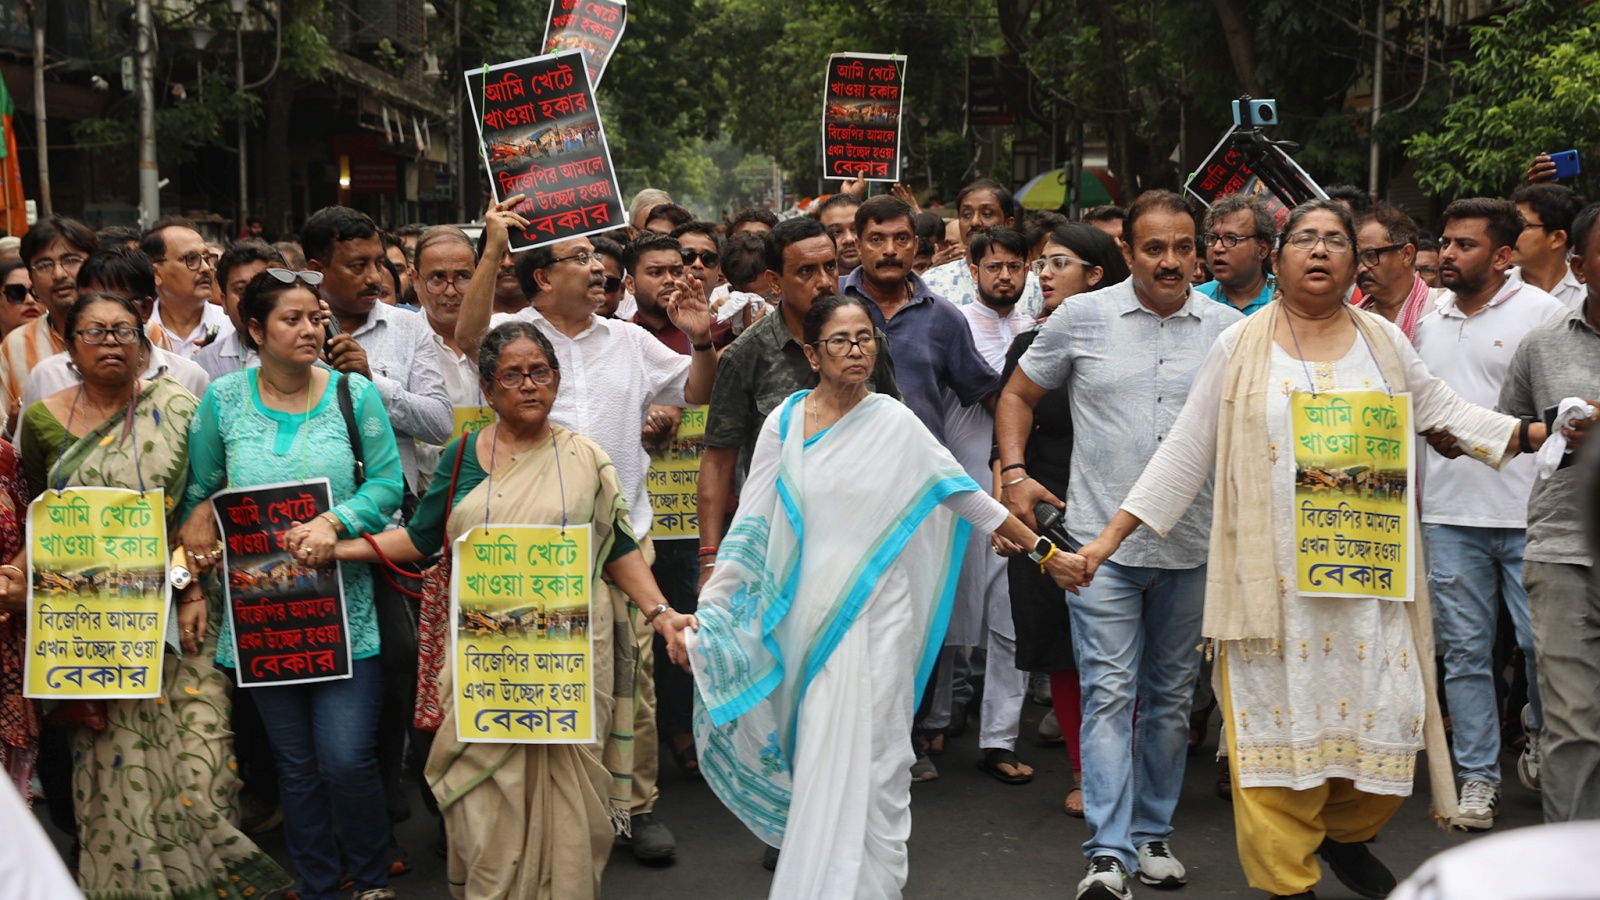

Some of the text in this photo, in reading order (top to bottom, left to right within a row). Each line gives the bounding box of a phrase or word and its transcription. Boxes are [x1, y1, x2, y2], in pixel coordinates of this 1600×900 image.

[585, 2, 619, 22] খেটে
[580, 16, 615, 40] হকার
[481, 64, 572, 102] আমি খেটে
[837, 61, 896, 80] আমি খেটে
[832, 82, 898, 99] খাওয়া হকার
[483, 92, 587, 130] খাওয়া হকার
[828, 124, 894, 142] বিজেপির আমলে
[828, 144, 894, 160] এখন উচ্ছেদ হওয়া
[498, 156, 604, 195] বিজেপির আমলে
[834, 160, 888, 176] বেকার
[1200, 163, 1228, 190] আমি
[512, 180, 612, 216] খন উচ্ছেদ হওয়া
[522, 203, 609, 240] বেকার
[681, 410, 704, 428] কার
[1304, 397, 1396, 430] আমি খেটে
[1300, 433, 1402, 460] খাওয়া হকার
[46, 496, 152, 528] আমি খেটে
[227, 491, 316, 526] আমি খেটে
[1301, 500, 1400, 534] বিজেপির আমলে
[40, 534, 159, 560] খাওয়া হকার
[228, 531, 270, 555] খাওয়া
[473, 534, 578, 566] আমি খেটে
[1300, 532, 1401, 562] এখন উচ্ছেদ হওয়া
[466, 572, 584, 599] খাওয়া হকার
[1309, 564, 1394, 590] বেকার
[38, 603, 159, 630] বিজেপির আমলে
[235, 598, 336, 624] বিজেপির আমলে
[36, 636, 158, 662] এখন উচ্ছেদ হওয়া
[240, 624, 341, 650] এখন উচ্ছেদ হওয়া
[251, 650, 335, 678] বেকার
[464, 644, 585, 673] বিজেপির আমলে
[46, 663, 148, 689] বেকার
[463, 678, 586, 706] এখন উচ্ছেদ হওয়া
[475, 706, 578, 734] বেকার
